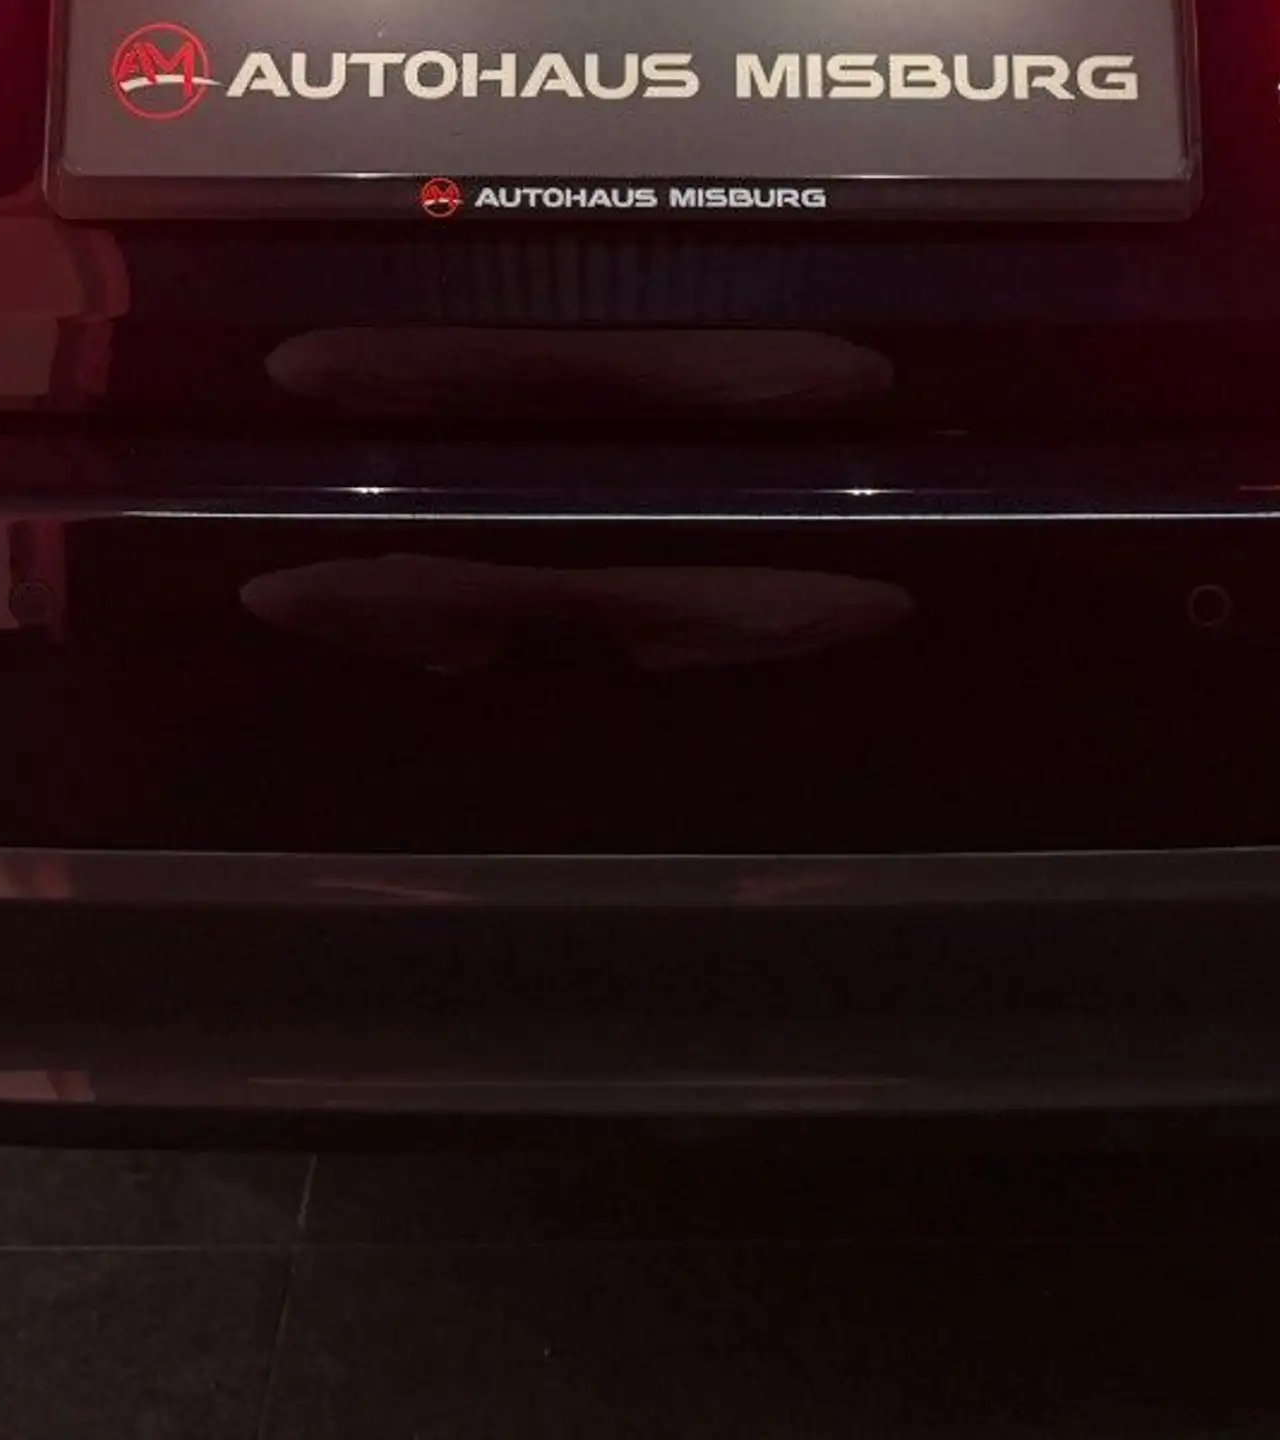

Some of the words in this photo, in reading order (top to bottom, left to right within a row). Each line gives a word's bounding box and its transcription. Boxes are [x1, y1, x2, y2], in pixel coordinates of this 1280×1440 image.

[225, 50, 700, 100] AUTOHAUS
[735, 52, 1139, 102] MISBURG
[474, 187, 658, 208] AUTOHAUS
[668, 187, 827, 208] MISBURG
